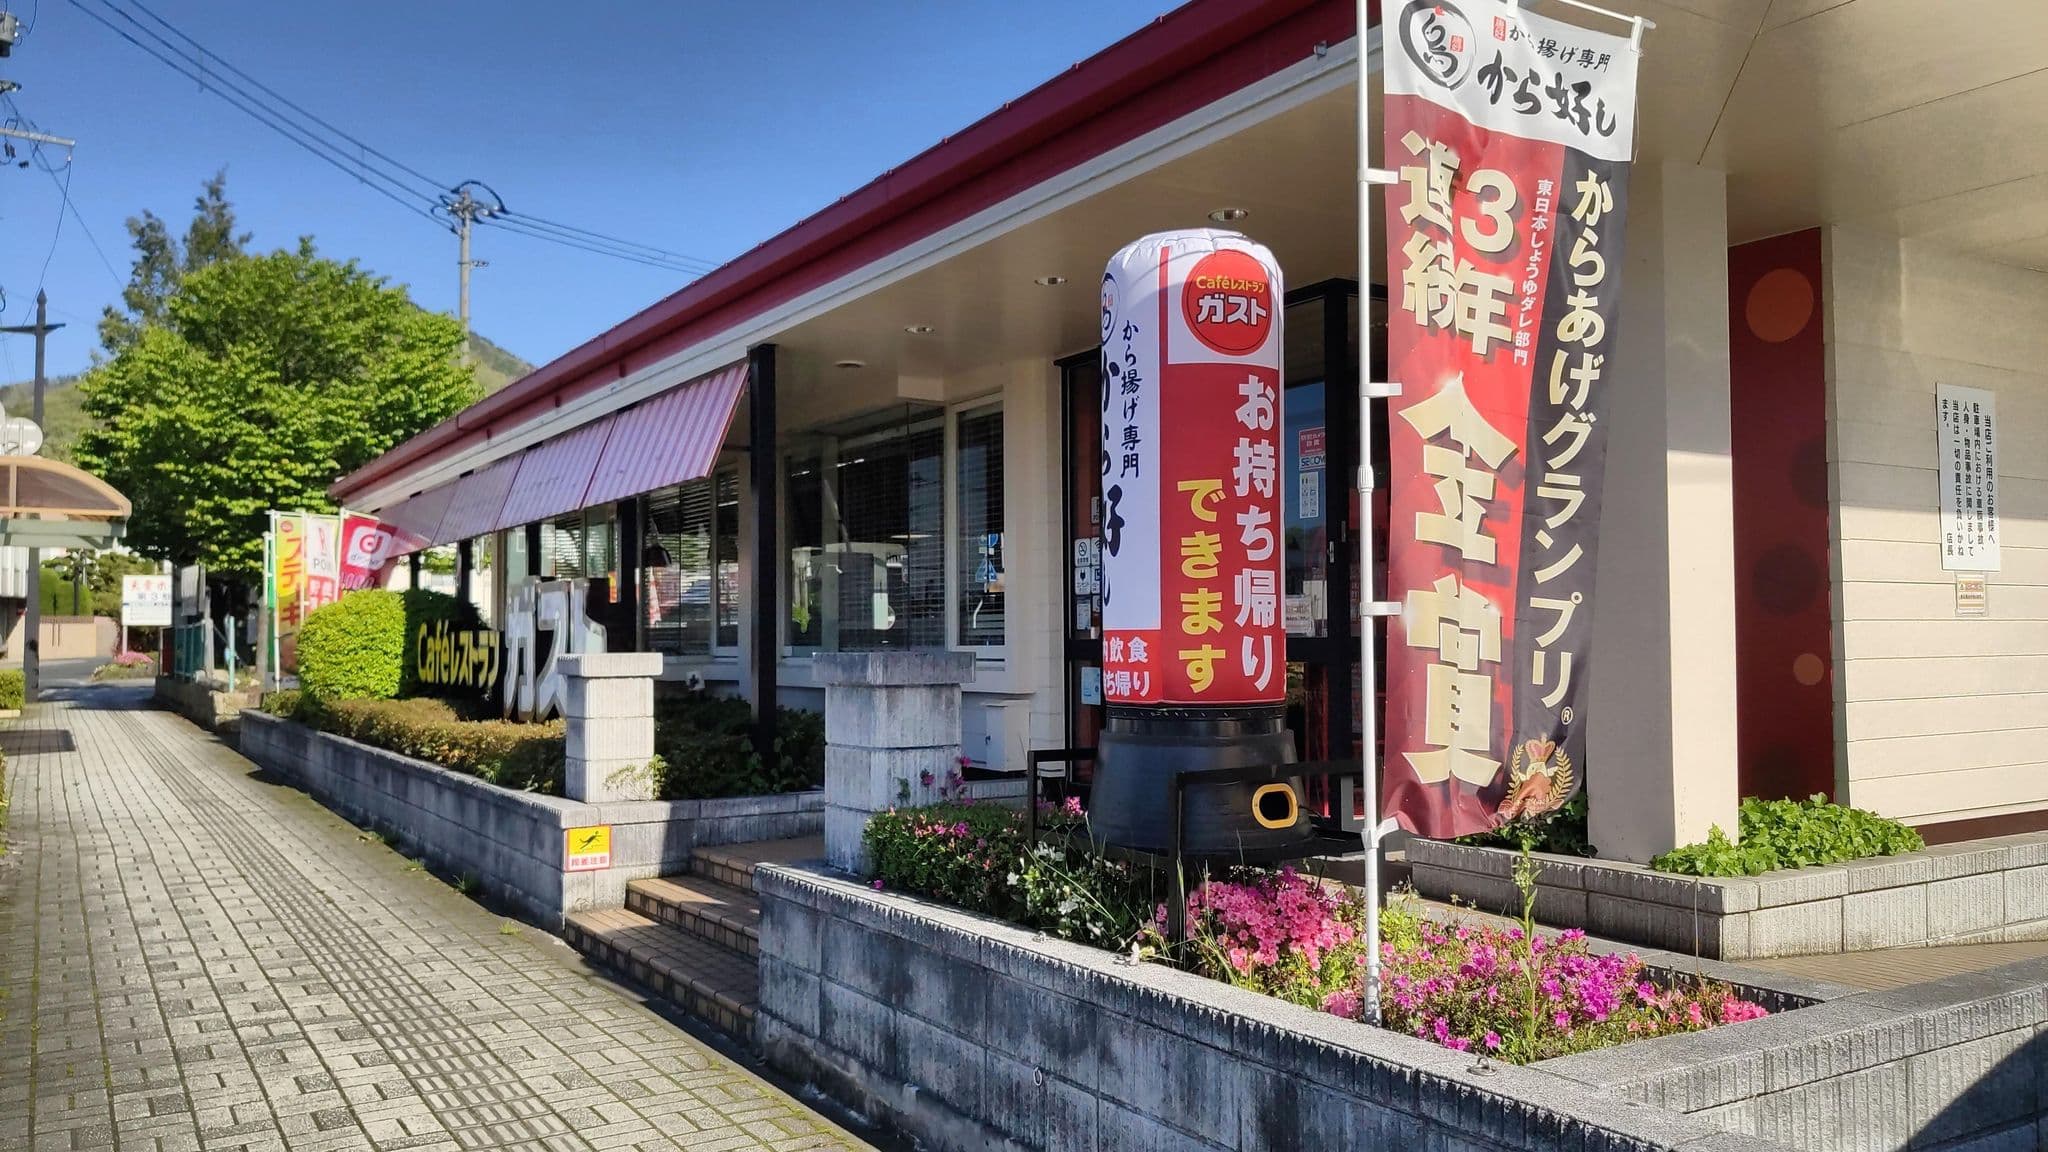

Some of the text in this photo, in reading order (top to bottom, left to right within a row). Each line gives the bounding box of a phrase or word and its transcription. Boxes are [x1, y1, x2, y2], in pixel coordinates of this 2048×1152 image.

[1477, 49, 1617, 137] から好し
[1196, 293, 1267, 326] ガスト
[1459, 169, 1516, 355] 3年
[1513, 179, 1554, 367] 東日本しょうゆダレ部門
[1120, 319, 1142, 479] から揚げ専門
[1177, 478, 1226, 694] できます
[1233, 374, 1277, 692] お持ち帰り
[418, 619, 500, 689] Caféレストラン
[1104, 636, 1149, 663] 飲食
